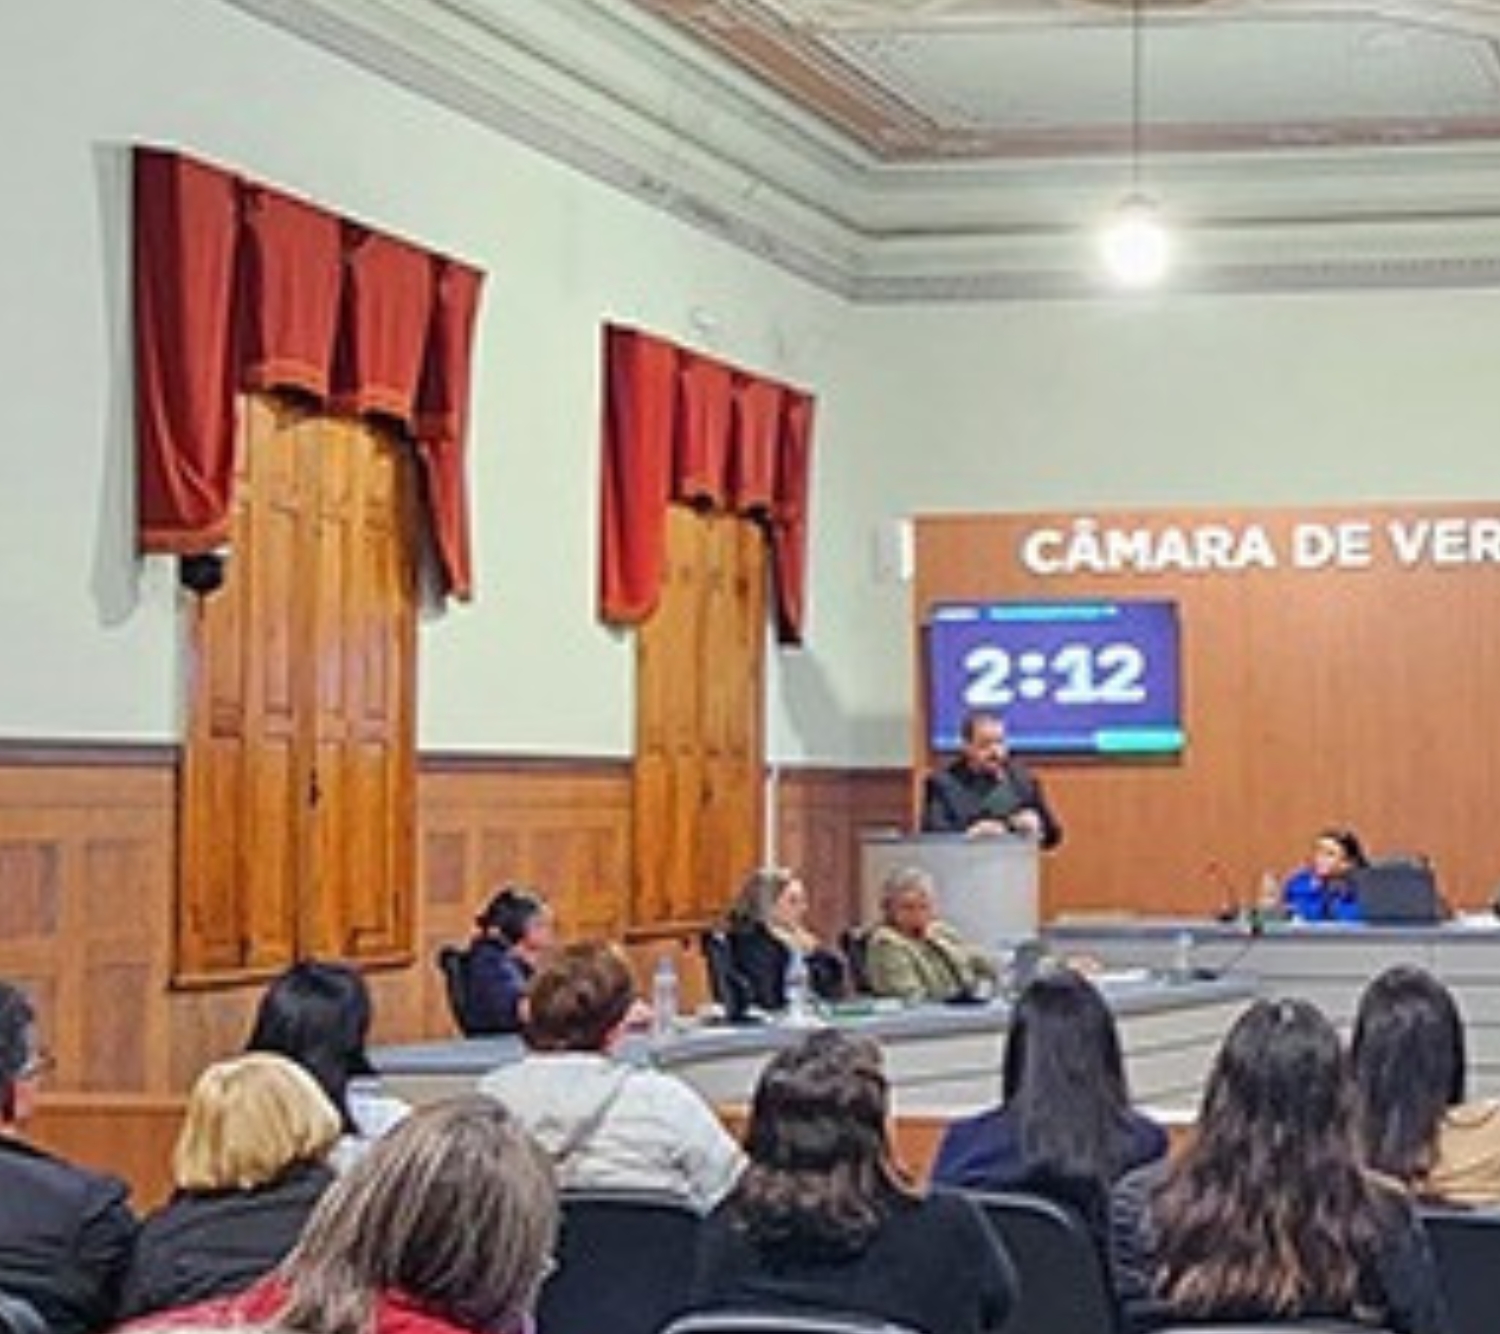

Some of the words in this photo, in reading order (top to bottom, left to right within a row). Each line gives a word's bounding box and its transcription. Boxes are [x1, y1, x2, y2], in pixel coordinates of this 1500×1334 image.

[1023, 517, 1275, 573] CÂMARA
[1293, 522, 1371, 568] DE
[964, 645, 1146, 704] 2:12
